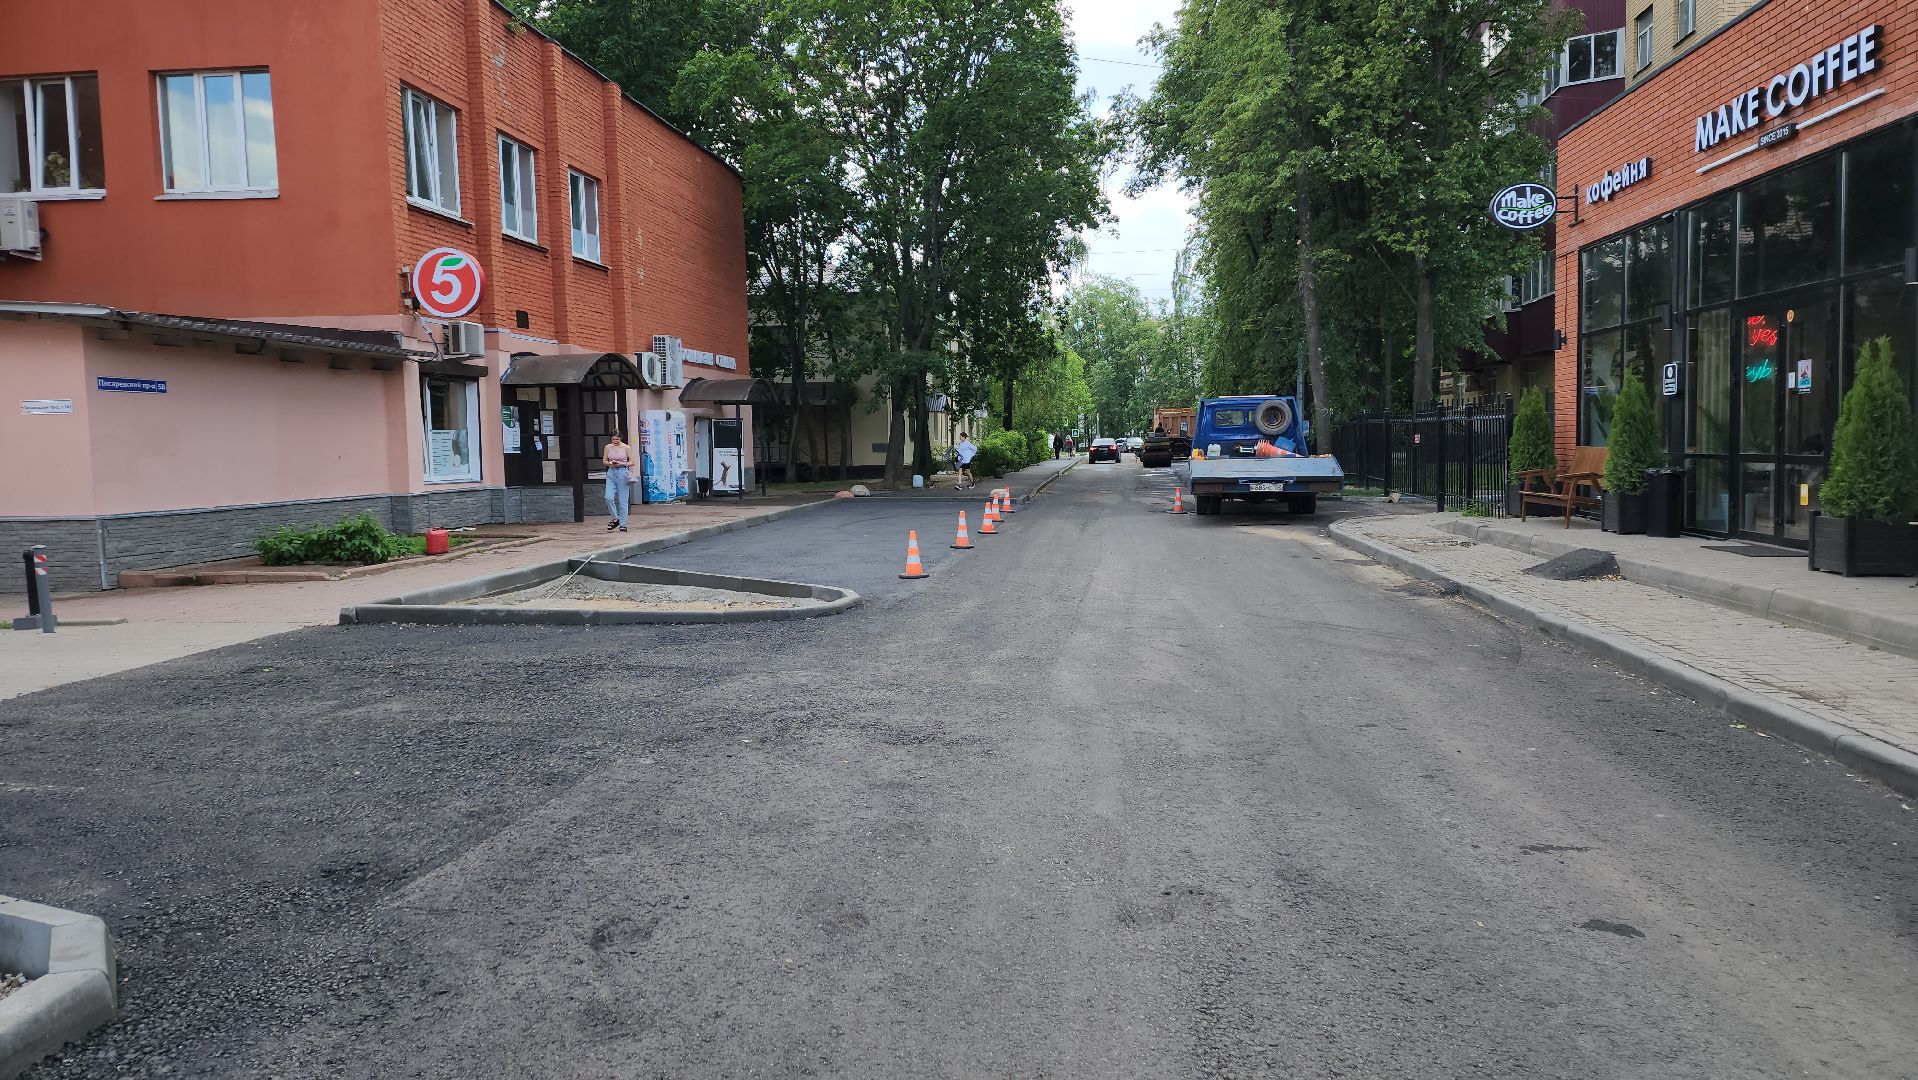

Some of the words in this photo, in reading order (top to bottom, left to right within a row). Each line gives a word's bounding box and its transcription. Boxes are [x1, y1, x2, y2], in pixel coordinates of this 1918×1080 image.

[1695, 87, 1760, 152] MAKE
[1766, 24, 1876, 117] COFFEE
[1760, 132, 1776, 146] SINCE
[1586, 157, 1647, 206] кофейня
[431, 255, 465, 305] 5
[98, 379, 142, 389] Писаревский
